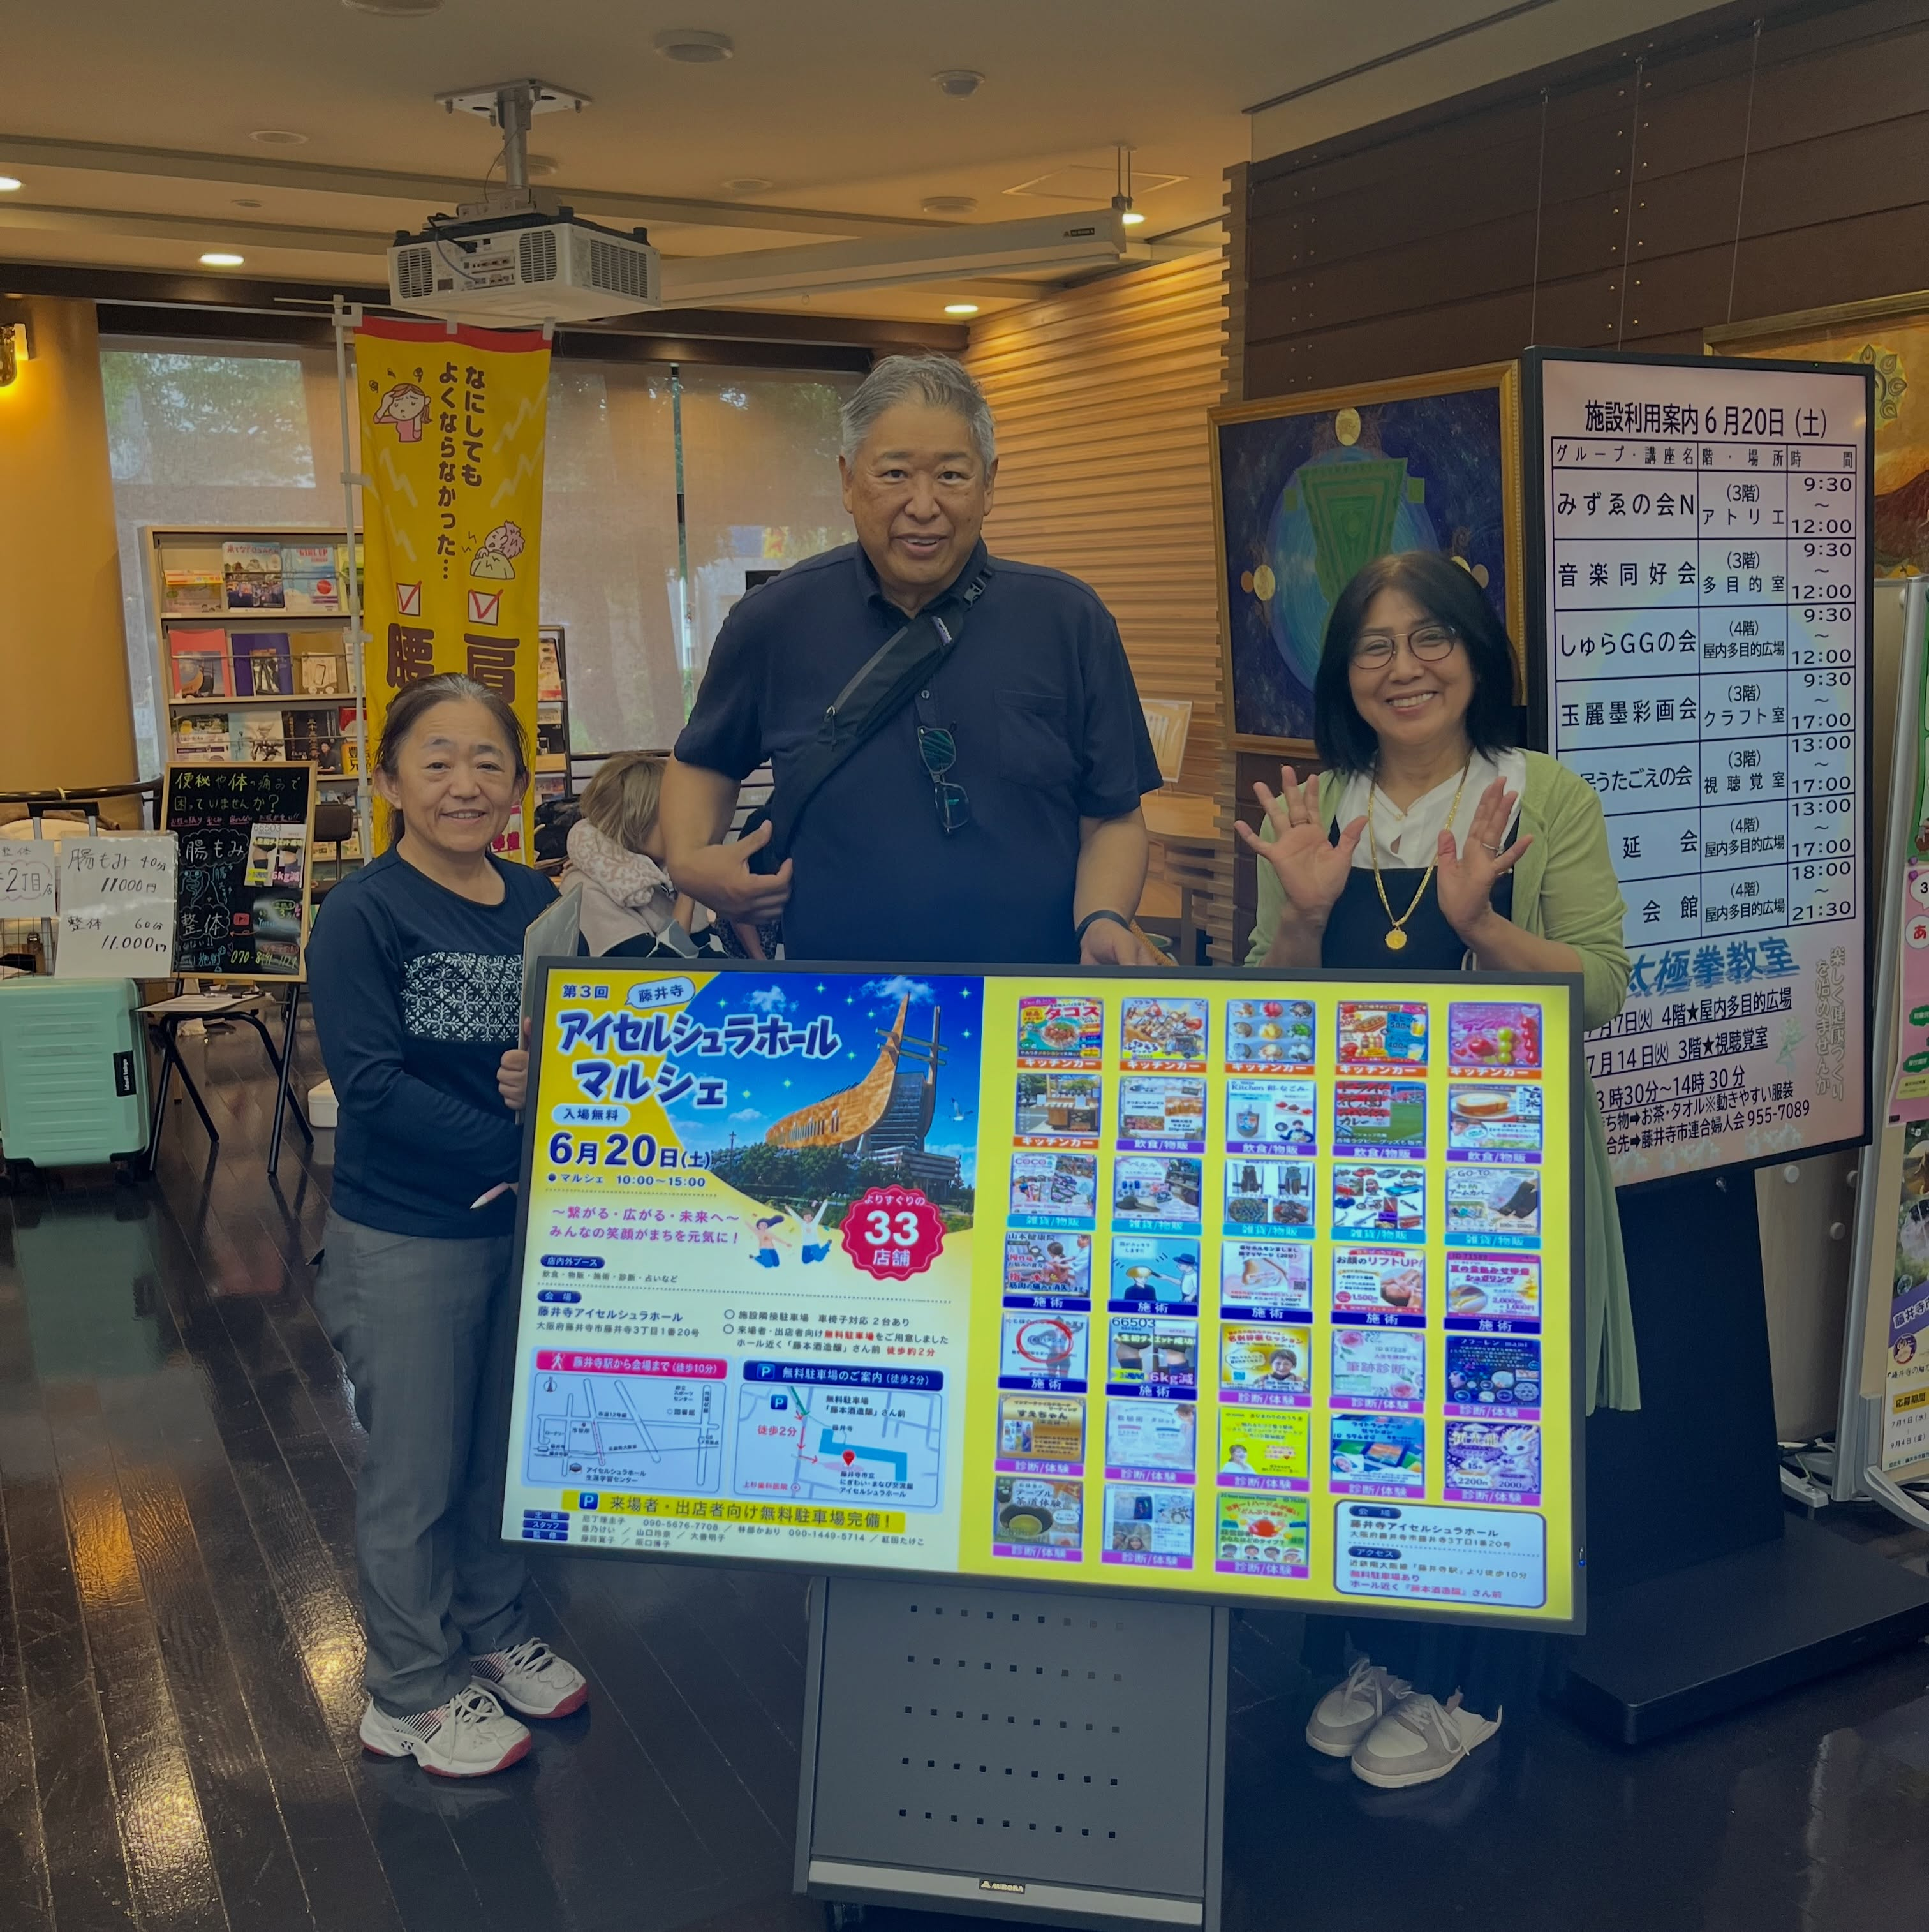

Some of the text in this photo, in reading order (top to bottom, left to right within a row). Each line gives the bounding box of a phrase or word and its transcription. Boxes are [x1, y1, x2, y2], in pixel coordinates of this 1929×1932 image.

[461, 366, 486, 487] なにしても
[1790, 450, 1854, 469] 時間
[1803, 477, 1852, 493] 9:30
[1726, 484, 1761, 503] (3階)
[1557, 493, 1695, 517] みずゑの会N
[1702, 509, 1785, 526] アトリエ
[1791, 518, 1852, 535] 12:00
[1803, 542, 1852, 558] 9:30
[1726, 551, 1761, 570] (3階)
[1558, 561, 1696, 588] 音楽同好会
[1703, 574, 1785, 594] 多目的室
[1791, 584, 1852, 600] 12:00
[1803, 607, 1851, 623] 9:30
[1729, 620, 1759, 637] (4階)
[1560, 628, 1697, 658] しゅらGGの会
[1703, 640, 1785, 660] 屋内多目的広場
[386, 623, 435, 688] 腰
[1791, 649, 1851, 665] 12:00
[1803, 671, 1851, 688] 9:30
[1727, 684, 1761, 702] (3階)
[1560, 697, 1697, 727] 玉麗墨彩画会
[1704, 706, 1785, 728] クラフト室
[1791, 712, 1851, 731] 17:00
[1791, 734, 1851, 753] 13:00
[1728, 750, 1761, 769] (3階)
[1704, 771, 1785, 794] 視聴覚室
[1791, 776, 1851, 794] 17:00
[1791, 798, 1851, 817] 13:00
[1729, 817, 1760, 833] (4階)
[186, 838, 244, 863] 腸もみ
[1704, 834, 1785, 858] 屋内多目的広場
[1791, 839, 1851, 858] 17:00
[67, 848, 128, 872] 腸もみ
[1791, 861, 1851, 881] 18:00
[1730, 881, 1760, 898] (4階)
[1704, 898, 1785, 923] 屋内多目的広場
[1791, 901, 1851, 921] 21:30
[67, 916, 103, 932] 整体
[181, 912, 225, 937] 整体
[1628, 936, 1800, 993] 太極拳教室
[562, 984, 685, 1005] 第3回 藤井寺
[1044, 1006, 1100, 1020] タコス
[558, 1009, 841, 1059] アイセルシュラホール
[1815, 958, 1831, 1096] を始めませんか
[1025, 1058, 1097, 1068] キッチンカー
[1127, 1060, 1200, 1071] キッチンカー
[1232, 1064, 1308, 1074] キッチンカー
[1339, 1065, 1417, 1074] キッチンカー
[1450, 1067, 1529, 1078] キッチンカー
[573, 1059, 727, 1108] マルシェ
[562, 1108, 619, 1123] 入場無料
[1747, 1099, 1810, 1128] 955-7089
[1021, 1137, 1095, 1147] キッチンカー
[1134, 1140, 1189, 1151] 飲食/物販
[1242, 1143, 1299, 1154] 飲食/物販
[548, 1131, 713, 1171] 6月20日(土)
[1354, 1147, 1411, 1159] 飲食/物販
[1467, 1152, 1527, 1163] 飲食/物販
[559, 1173, 605, 1185] マルシェ
[864, 1193, 926, 1207] よりすぐりの
[864, 1210, 920, 1247] 33
[1026, 1215, 1080, 1227] 雑貨/物販
[1129, 1219, 1184, 1230] 雑貨/物販
[1242, 1225, 1298, 1237] 雑貨/物販
[1350, 1229, 1408, 1240] 雑貨/物販
[1466, 1235, 1525, 1247] 雑貨/物販
[547, 1256, 598, 1267] 店内外ブース
[872, 1249, 910, 1267] 店舗
[1033, 1296, 1064, 1308] 施術
[1137, 1302, 1169, 1314] 施術
[537, 1306, 684, 1323] 藤井寺アイセルシュラホール
[738, 1310, 809, 1323] 施設隣接駐車場
[818, 1314, 869, 1325] 車椅子対応
[1252, 1307, 1283, 1319] 施術
[1366, 1312, 1399, 1325] 施術
[536, 1321, 700, 1338] 大阪府藤井寺市藤井寺3丁目1番20号
[1112, 1316, 1156, 1328] 66503
[1479, 1319, 1512, 1332] 施術
[737, 1325, 949, 1345] 来場者・出店者向け無料駐車場をご用意しました
[886, 1346, 936, 1358] 徒歩約2分
[1031, 1378, 1062, 1390] 施術
[1149, 1372, 1194, 1385] 6kg減
[1139, 1385, 1171, 1398] 施術
[1238, 1392, 1296, 1404] 診断/体験
[826, 1395, 869, 1405] 無料駐車場
[1351, 1398, 1410, 1410] 診断/体験
[1895, 1392, 1926, 1408] 応募期間
[1459, 1405, 1519, 1418] 診断/体験
[757, 1425, 797, 1437] 徒歩2分
[586, 1467, 647, 1477] アイセルシュラホール
[1015, 1460, 1070, 1474] 診断/体験
[1121, 1467, 1177, 1481] 診断/体験
[585, 1474, 639, 1483] 生涯学習センター
[1234, 1476, 1292, 1490] 診断/体験
[839, 1487, 906, 1497] アイセルシュラホール
[1349, 1483, 1408, 1497] 診断/体験
[1461, 1490, 1522, 1504] 診断/体験
[532, 1520, 560, 1529] スタッフ
[1350, 1519, 1499, 1538] 藤井寺アイセルシュラホール
[1350, 1531, 1511, 1549] 大阪府藤井寺市藤井寺3丁目1番20号
[1011, 1543, 1067, 1559] 診断/体験
[1121, 1552, 1178, 1566] 診断/体験
[1356, 1549, 1395, 1558] アクセス
[1234, 1561, 1292, 1575] 診断/体験
[1349, 1570, 1421, 1582] 無料駐車場あり
[991, 1882, 1025, 1893] AURORA
